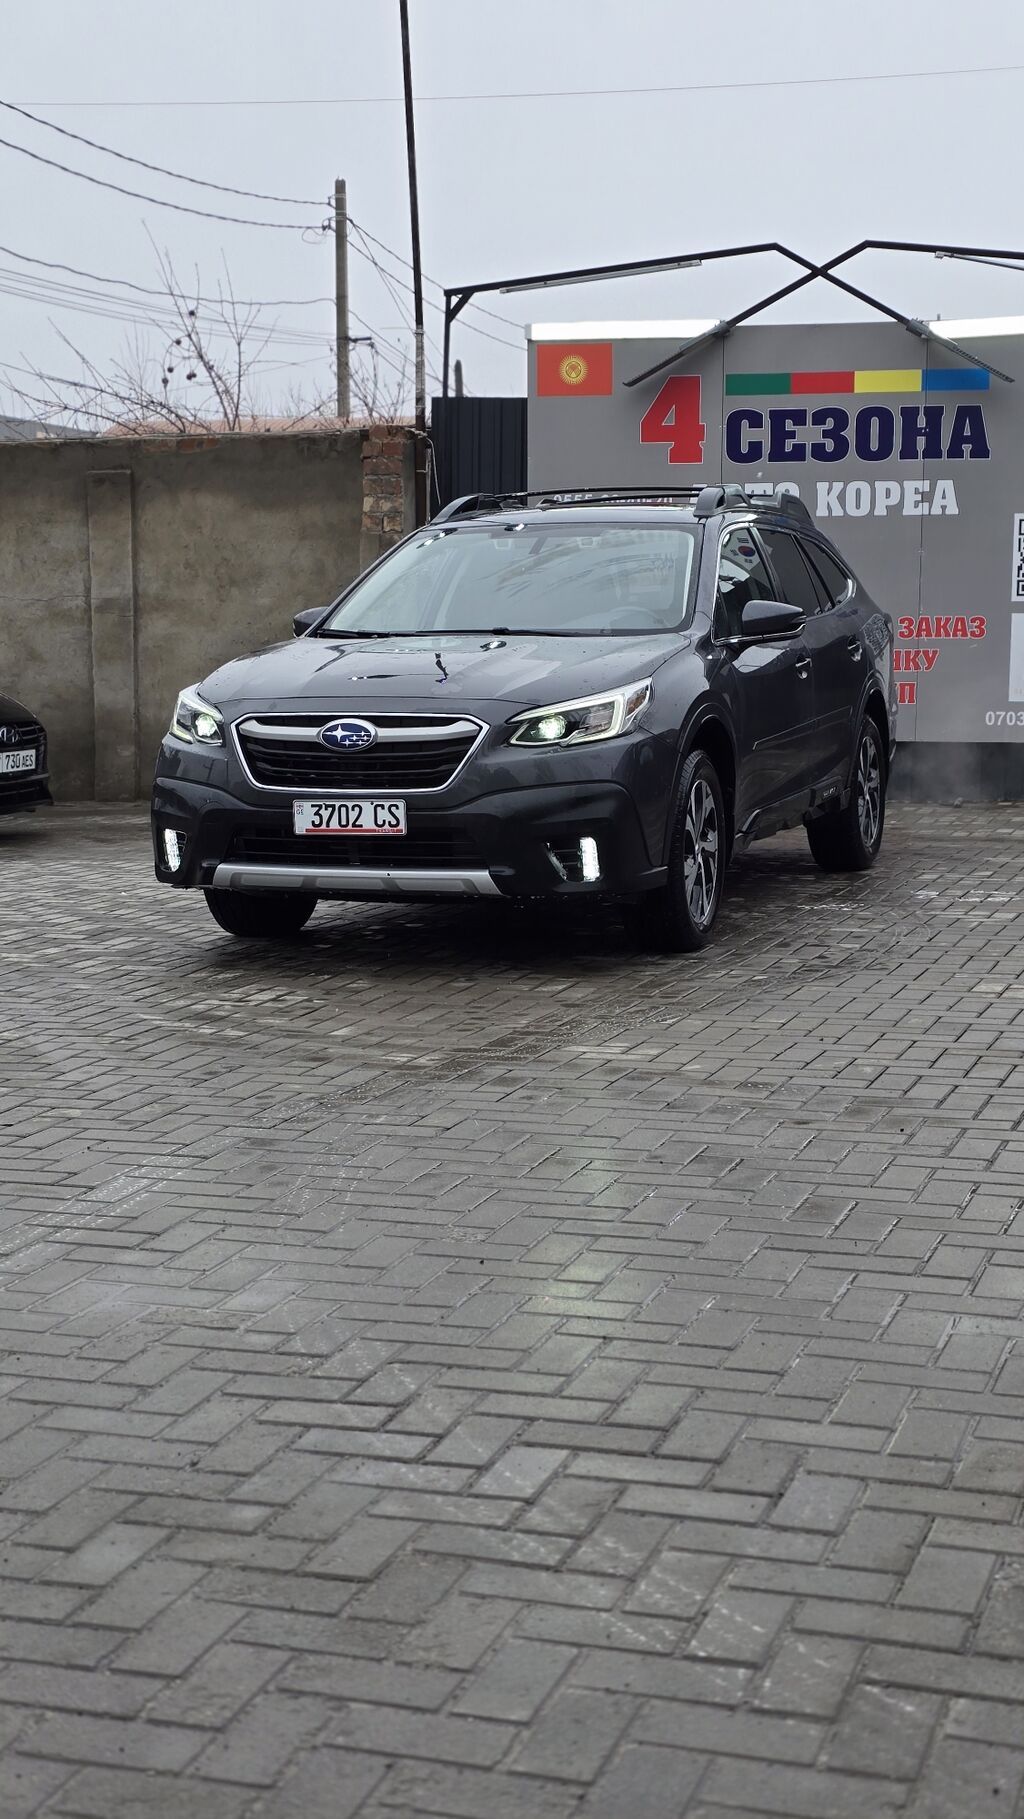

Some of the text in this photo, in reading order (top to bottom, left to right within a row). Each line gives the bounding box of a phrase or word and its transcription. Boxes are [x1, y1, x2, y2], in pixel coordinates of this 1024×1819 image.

[640, 375, 991, 464] 4 СЕЗОНА
[816, 479, 960, 517] КОРЕА
[898, 615, 987, 640] ЗАКАЗ
[5, 753, 20, 770] 730
[310, 803, 401, 829] 3702 CS
